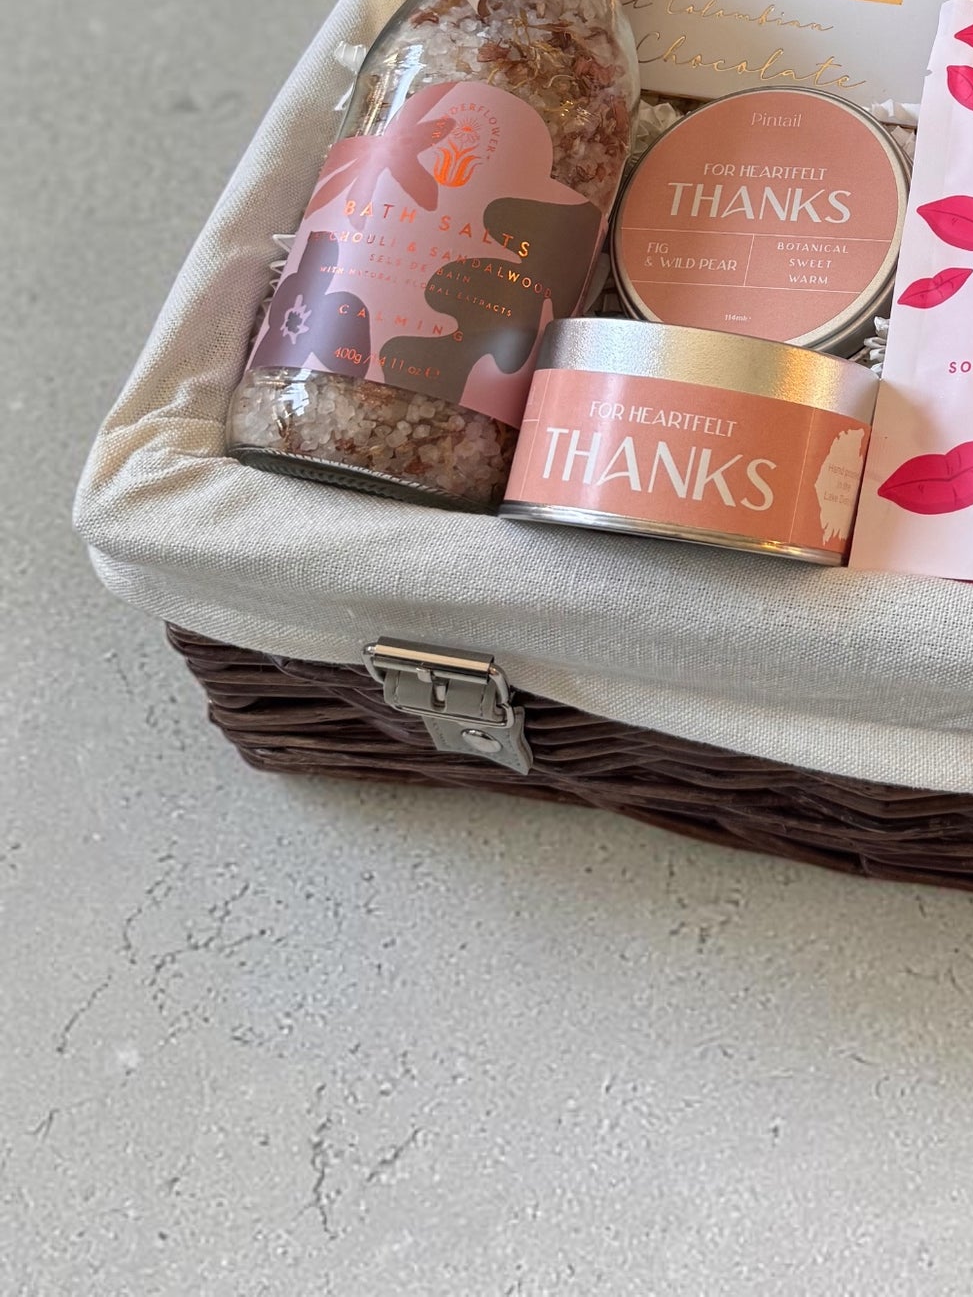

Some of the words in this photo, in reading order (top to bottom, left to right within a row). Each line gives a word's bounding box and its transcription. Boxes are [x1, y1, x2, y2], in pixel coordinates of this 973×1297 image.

[636, 32, 866, 88] Chocolate
[751, 112, 802, 128] Pintail
[704, 163, 735, 177] FOR
[739, 165, 828, 181] HEARTFELT
[668, 182, 851, 224] THANKS
[343, 200, 417, 223] BATH
[439, 215, 530, 257] SALTS
[647, 242, 669, 254] FIG
[777, 241, 849, 254] BOTANICAL
[430, 246, 552, 298] SANDALWOOD
[644, 256, 653, 267] &
[660, 256, 695, 269] WILD
[699, 258, 737, 271] PEAR
[789, 257, 832, 269] SWEET
[436, 268, 471, 284] BAIN
[788, 273, 828, 285] WARM
[457, 292, 512, 317] EXTRACTS
[339, 304, 464, 342] CALMING
[334, 346, 362, 365] 400g
[589, 401, 623, 420] FOR
[629, 405, 738, 438] HEARTFELT
[542, 427, 777, 511] THANKS
